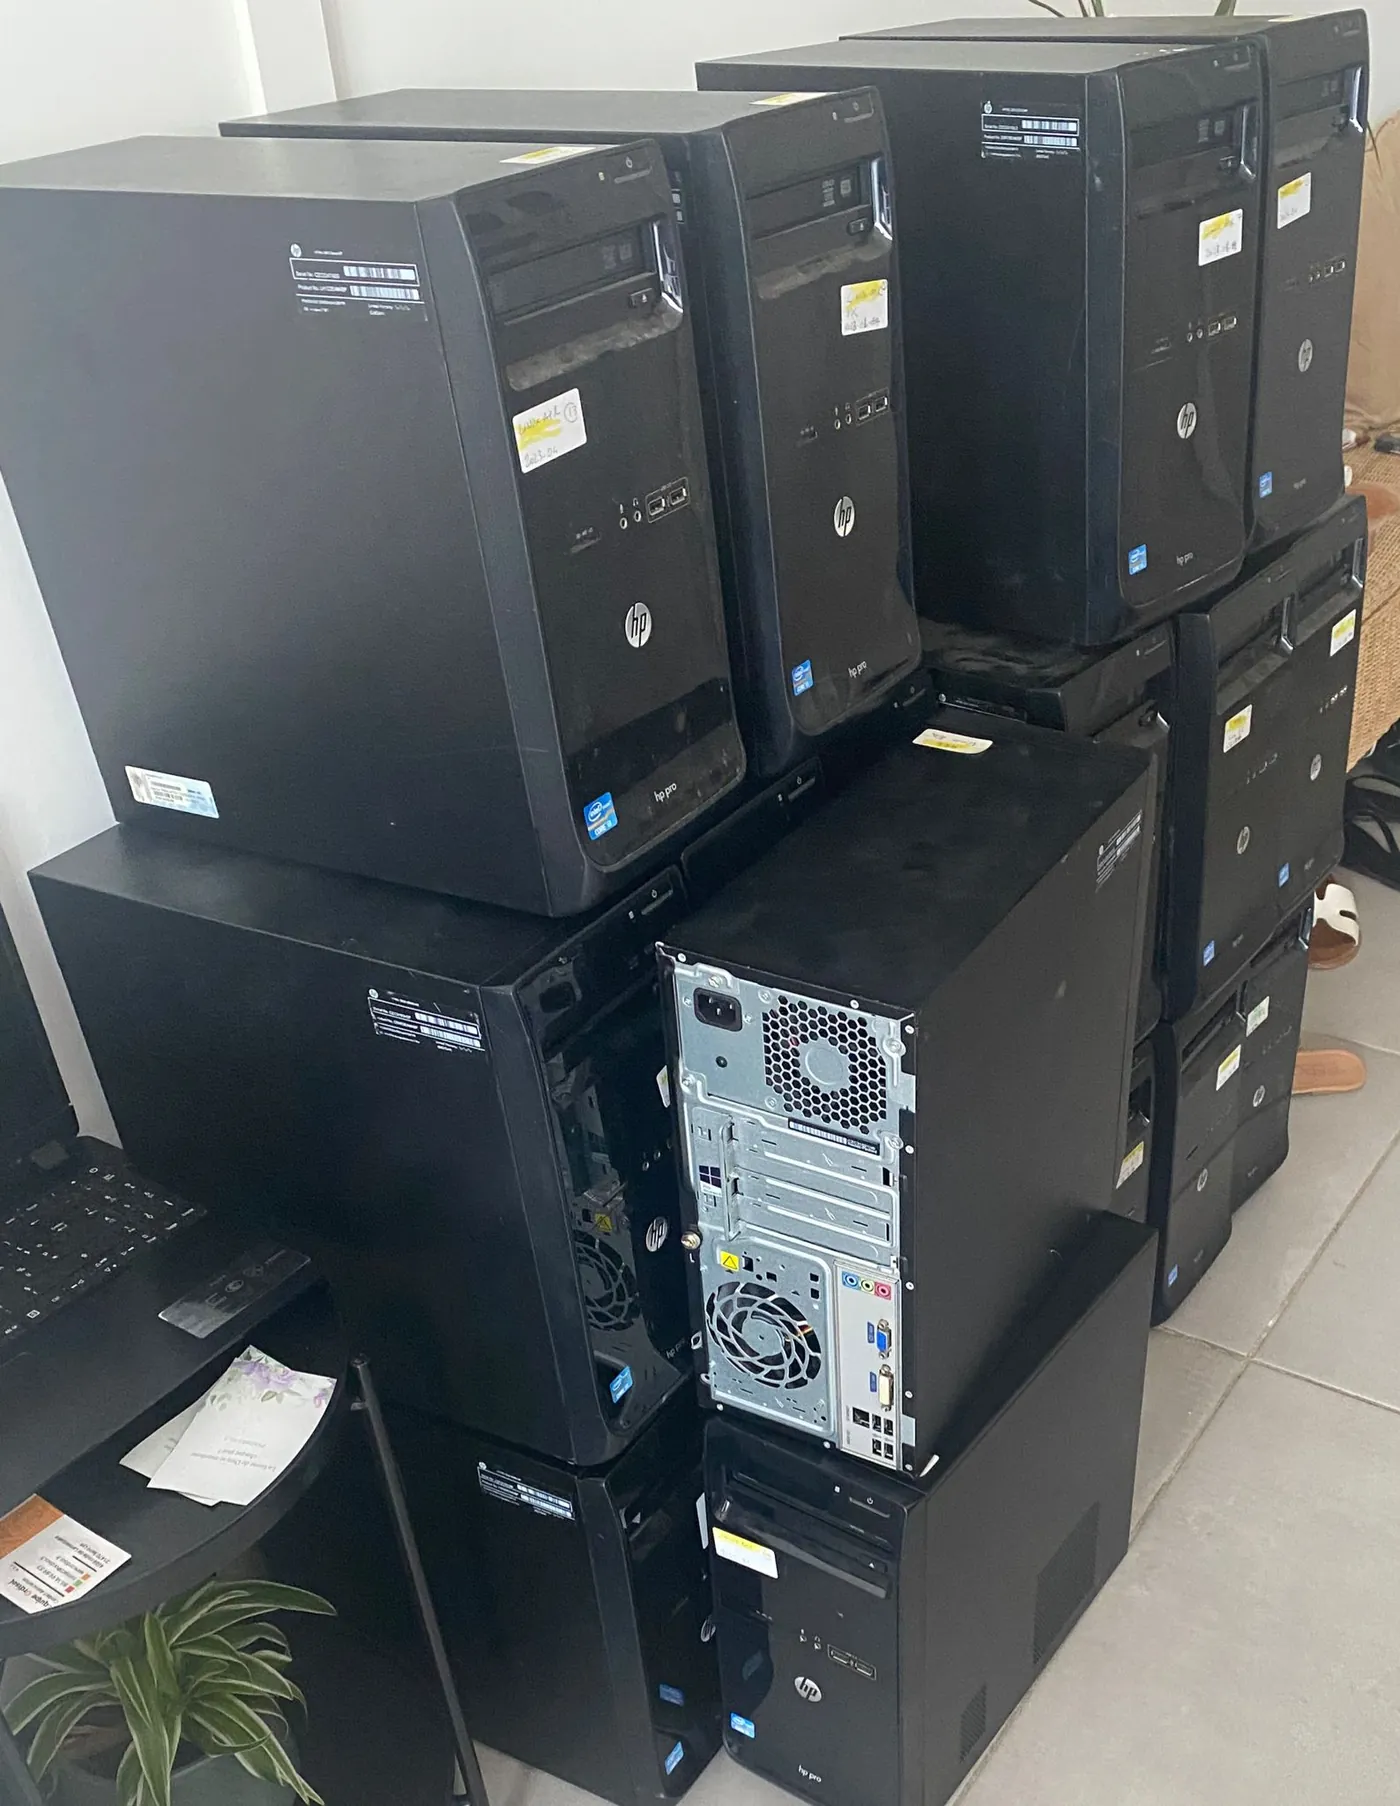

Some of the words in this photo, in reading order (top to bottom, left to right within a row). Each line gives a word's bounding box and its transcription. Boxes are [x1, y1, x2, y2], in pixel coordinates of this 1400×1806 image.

[1177, 402, 1197, 439] hp
[834, 496, 855, 537] hp
[624, 602, 652, 648] hp
[665, 782, 677, 796] pro
[646, 1216, 668, 1252] hp
[794, 1676, 822, 1702] hp
[808, 1771, 822, 1783] pro
